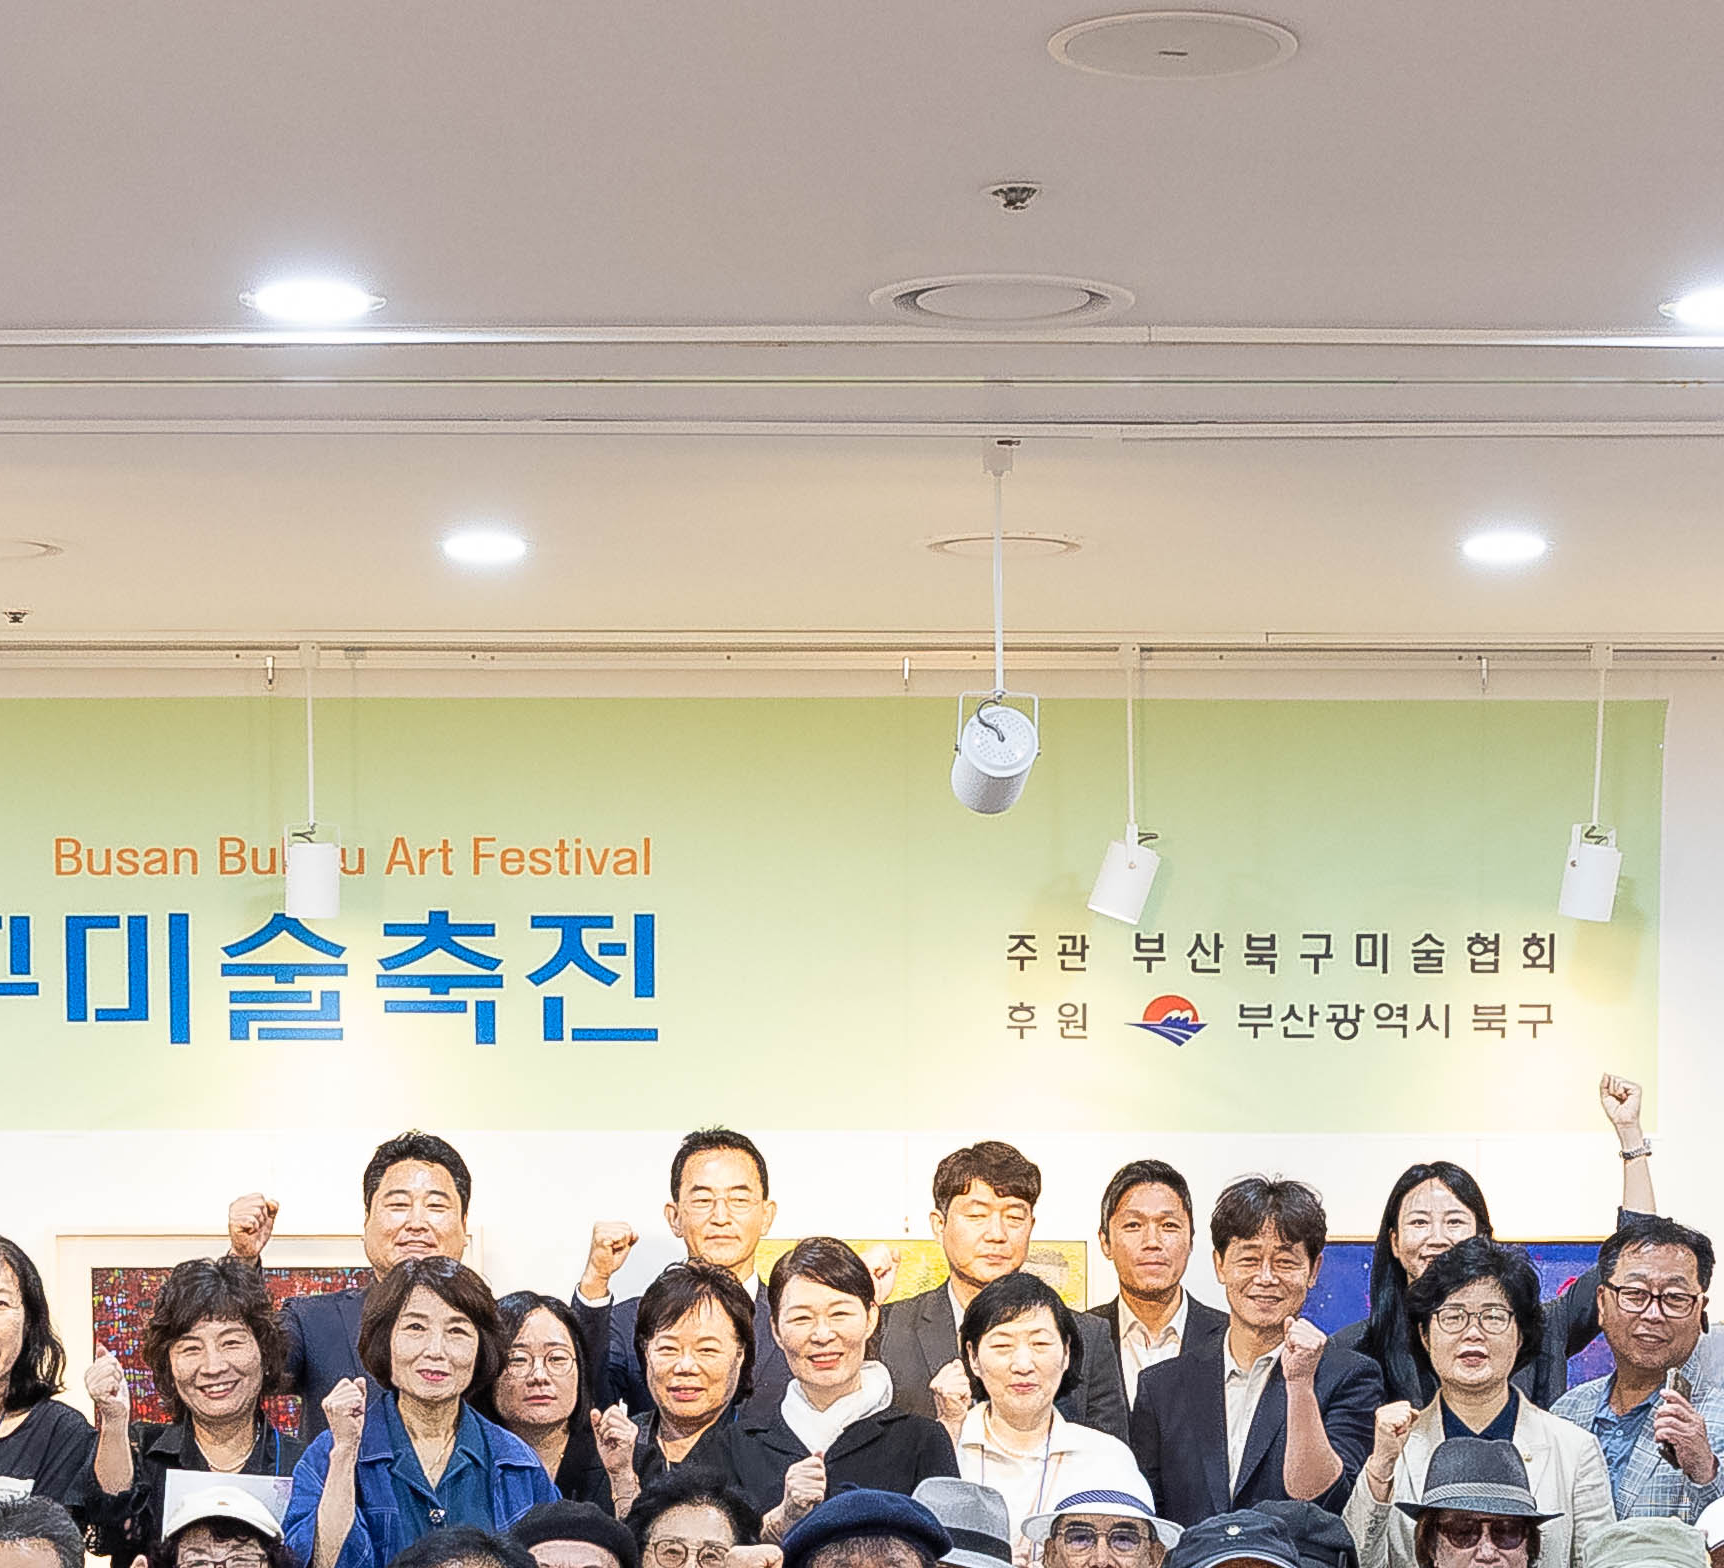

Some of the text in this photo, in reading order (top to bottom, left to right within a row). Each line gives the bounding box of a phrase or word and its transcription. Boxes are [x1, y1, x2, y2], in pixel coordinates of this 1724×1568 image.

[54, 836, 652, 878] Busan Buu Art Festival
[1006, 933, 1092, 974] 주관
[1005, 1000, 1555, 1043] 후원 부산광역시 북구
